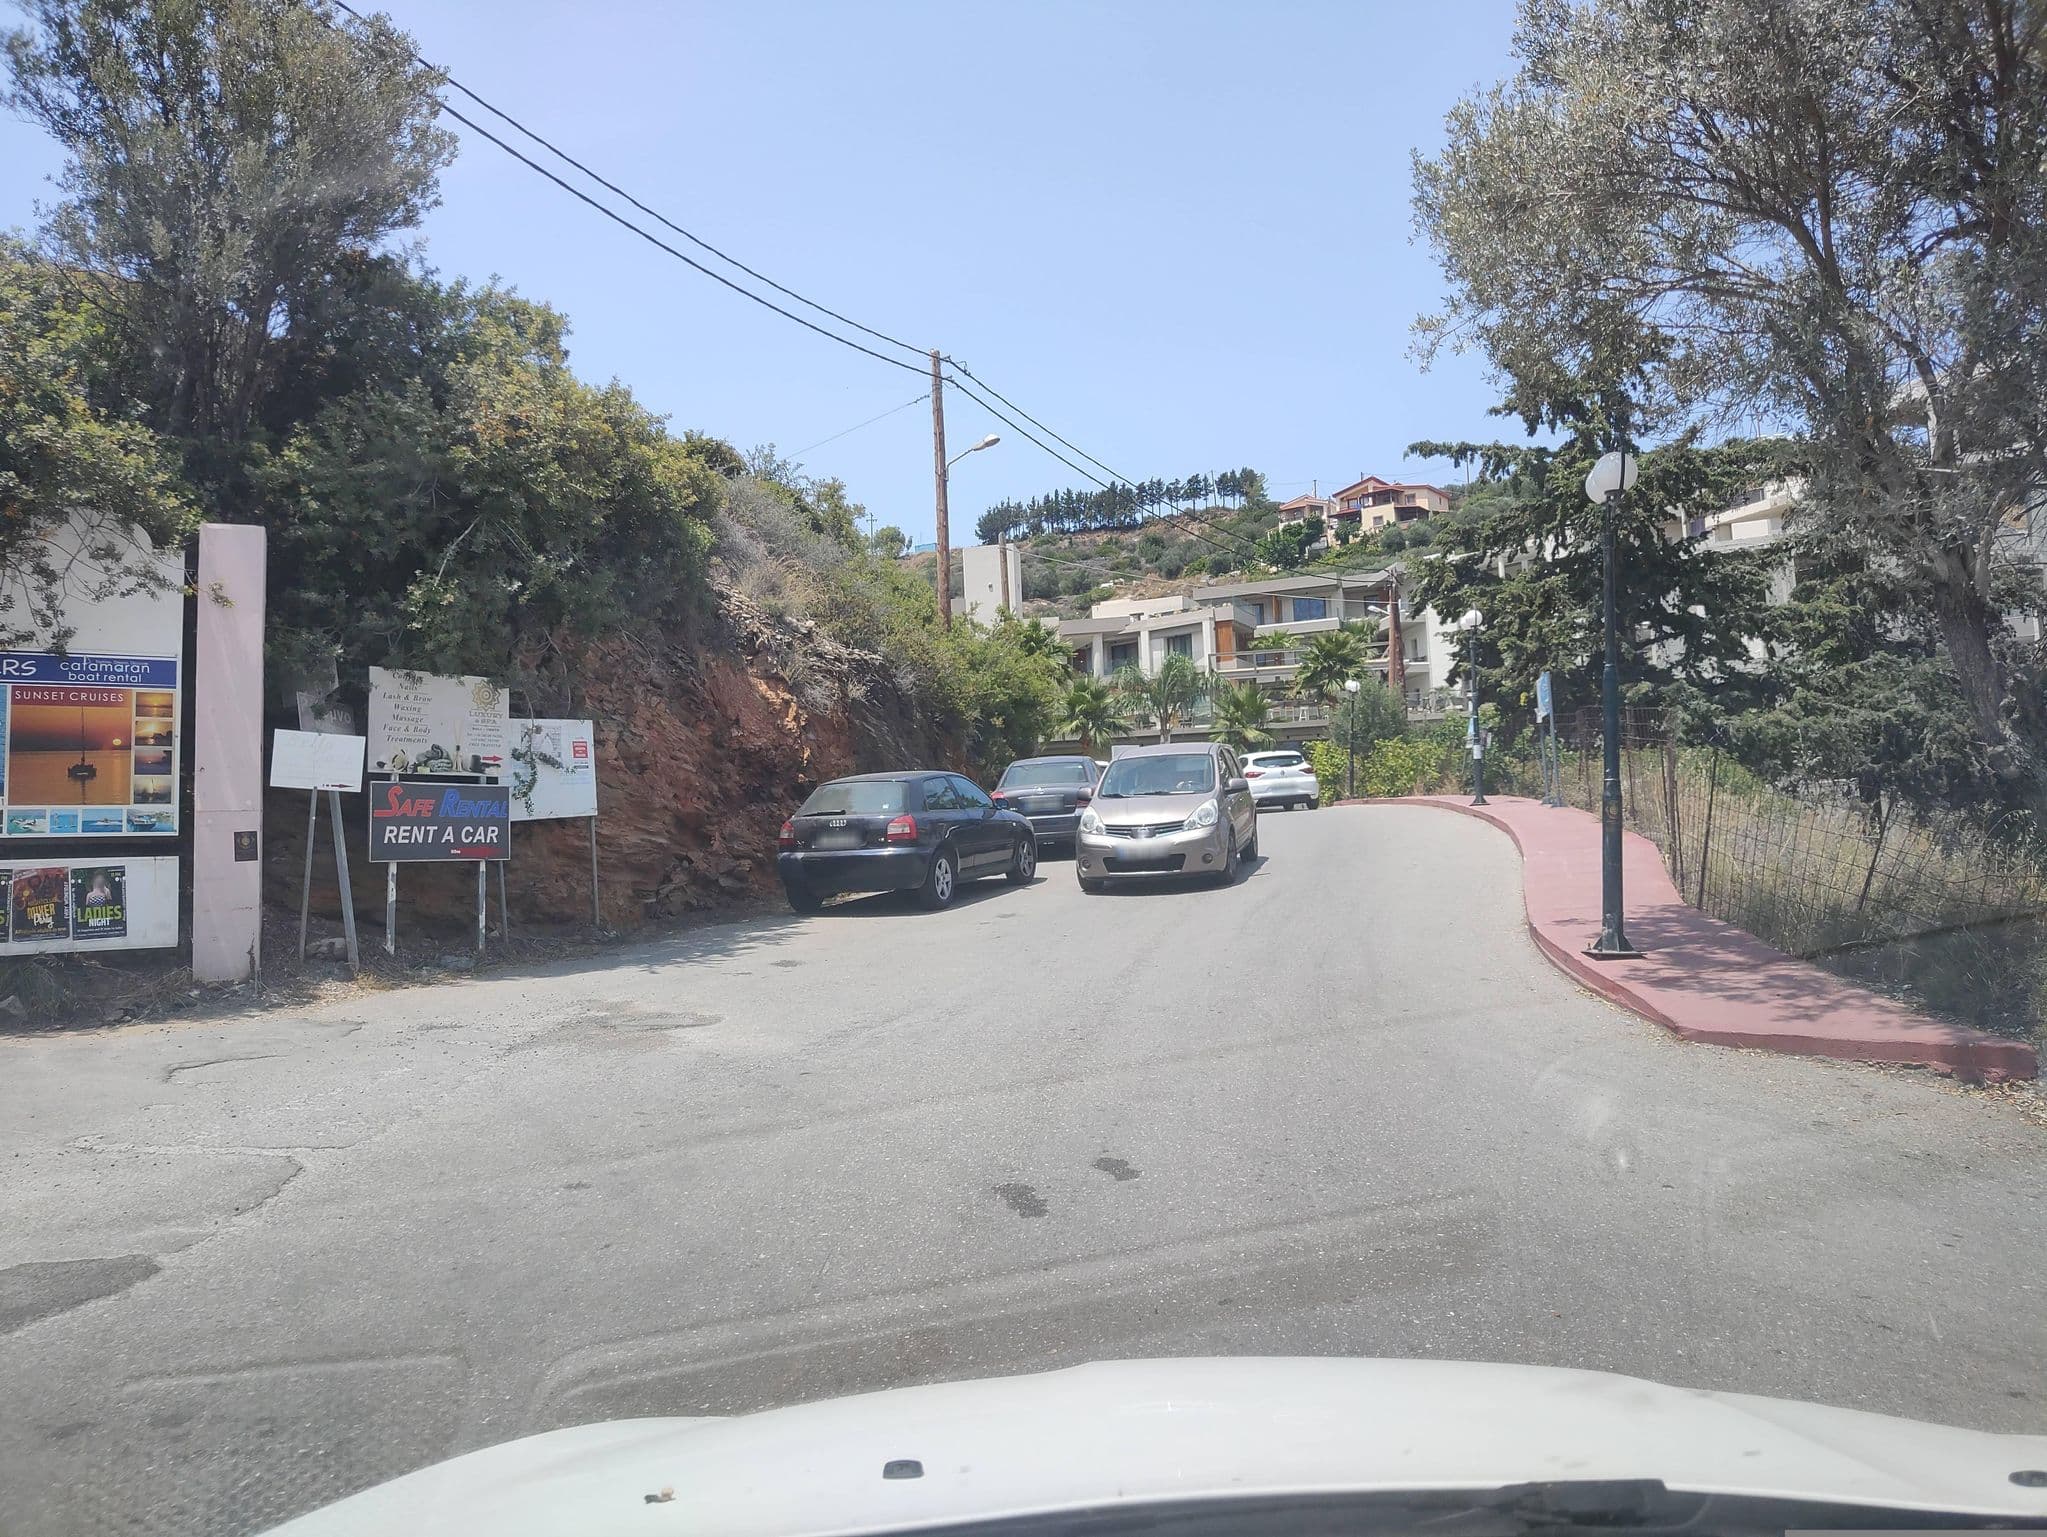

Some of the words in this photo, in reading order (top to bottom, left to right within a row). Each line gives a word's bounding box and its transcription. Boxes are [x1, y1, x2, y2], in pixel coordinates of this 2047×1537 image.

[0, 659, 37, 676] RS
[60, 656, 150, 673] catamaran
[68, 672, 100, 681] boat
[103, 673, 142, 683] rental
[15, 690, 65, 701] SUNSET
[69, 691, 124, 702] CRUISES
[374, 785, 436, 817] SAFE
[439, 788, 508, 818] RENTAL
[384, 826, 438, 844] RENT
[441, 826, 455, 844] A
[461, 825, 499, 844] CAR
[77, 905, 122, 923] LADIES
[89, 917, 111, 927] NIGHT
